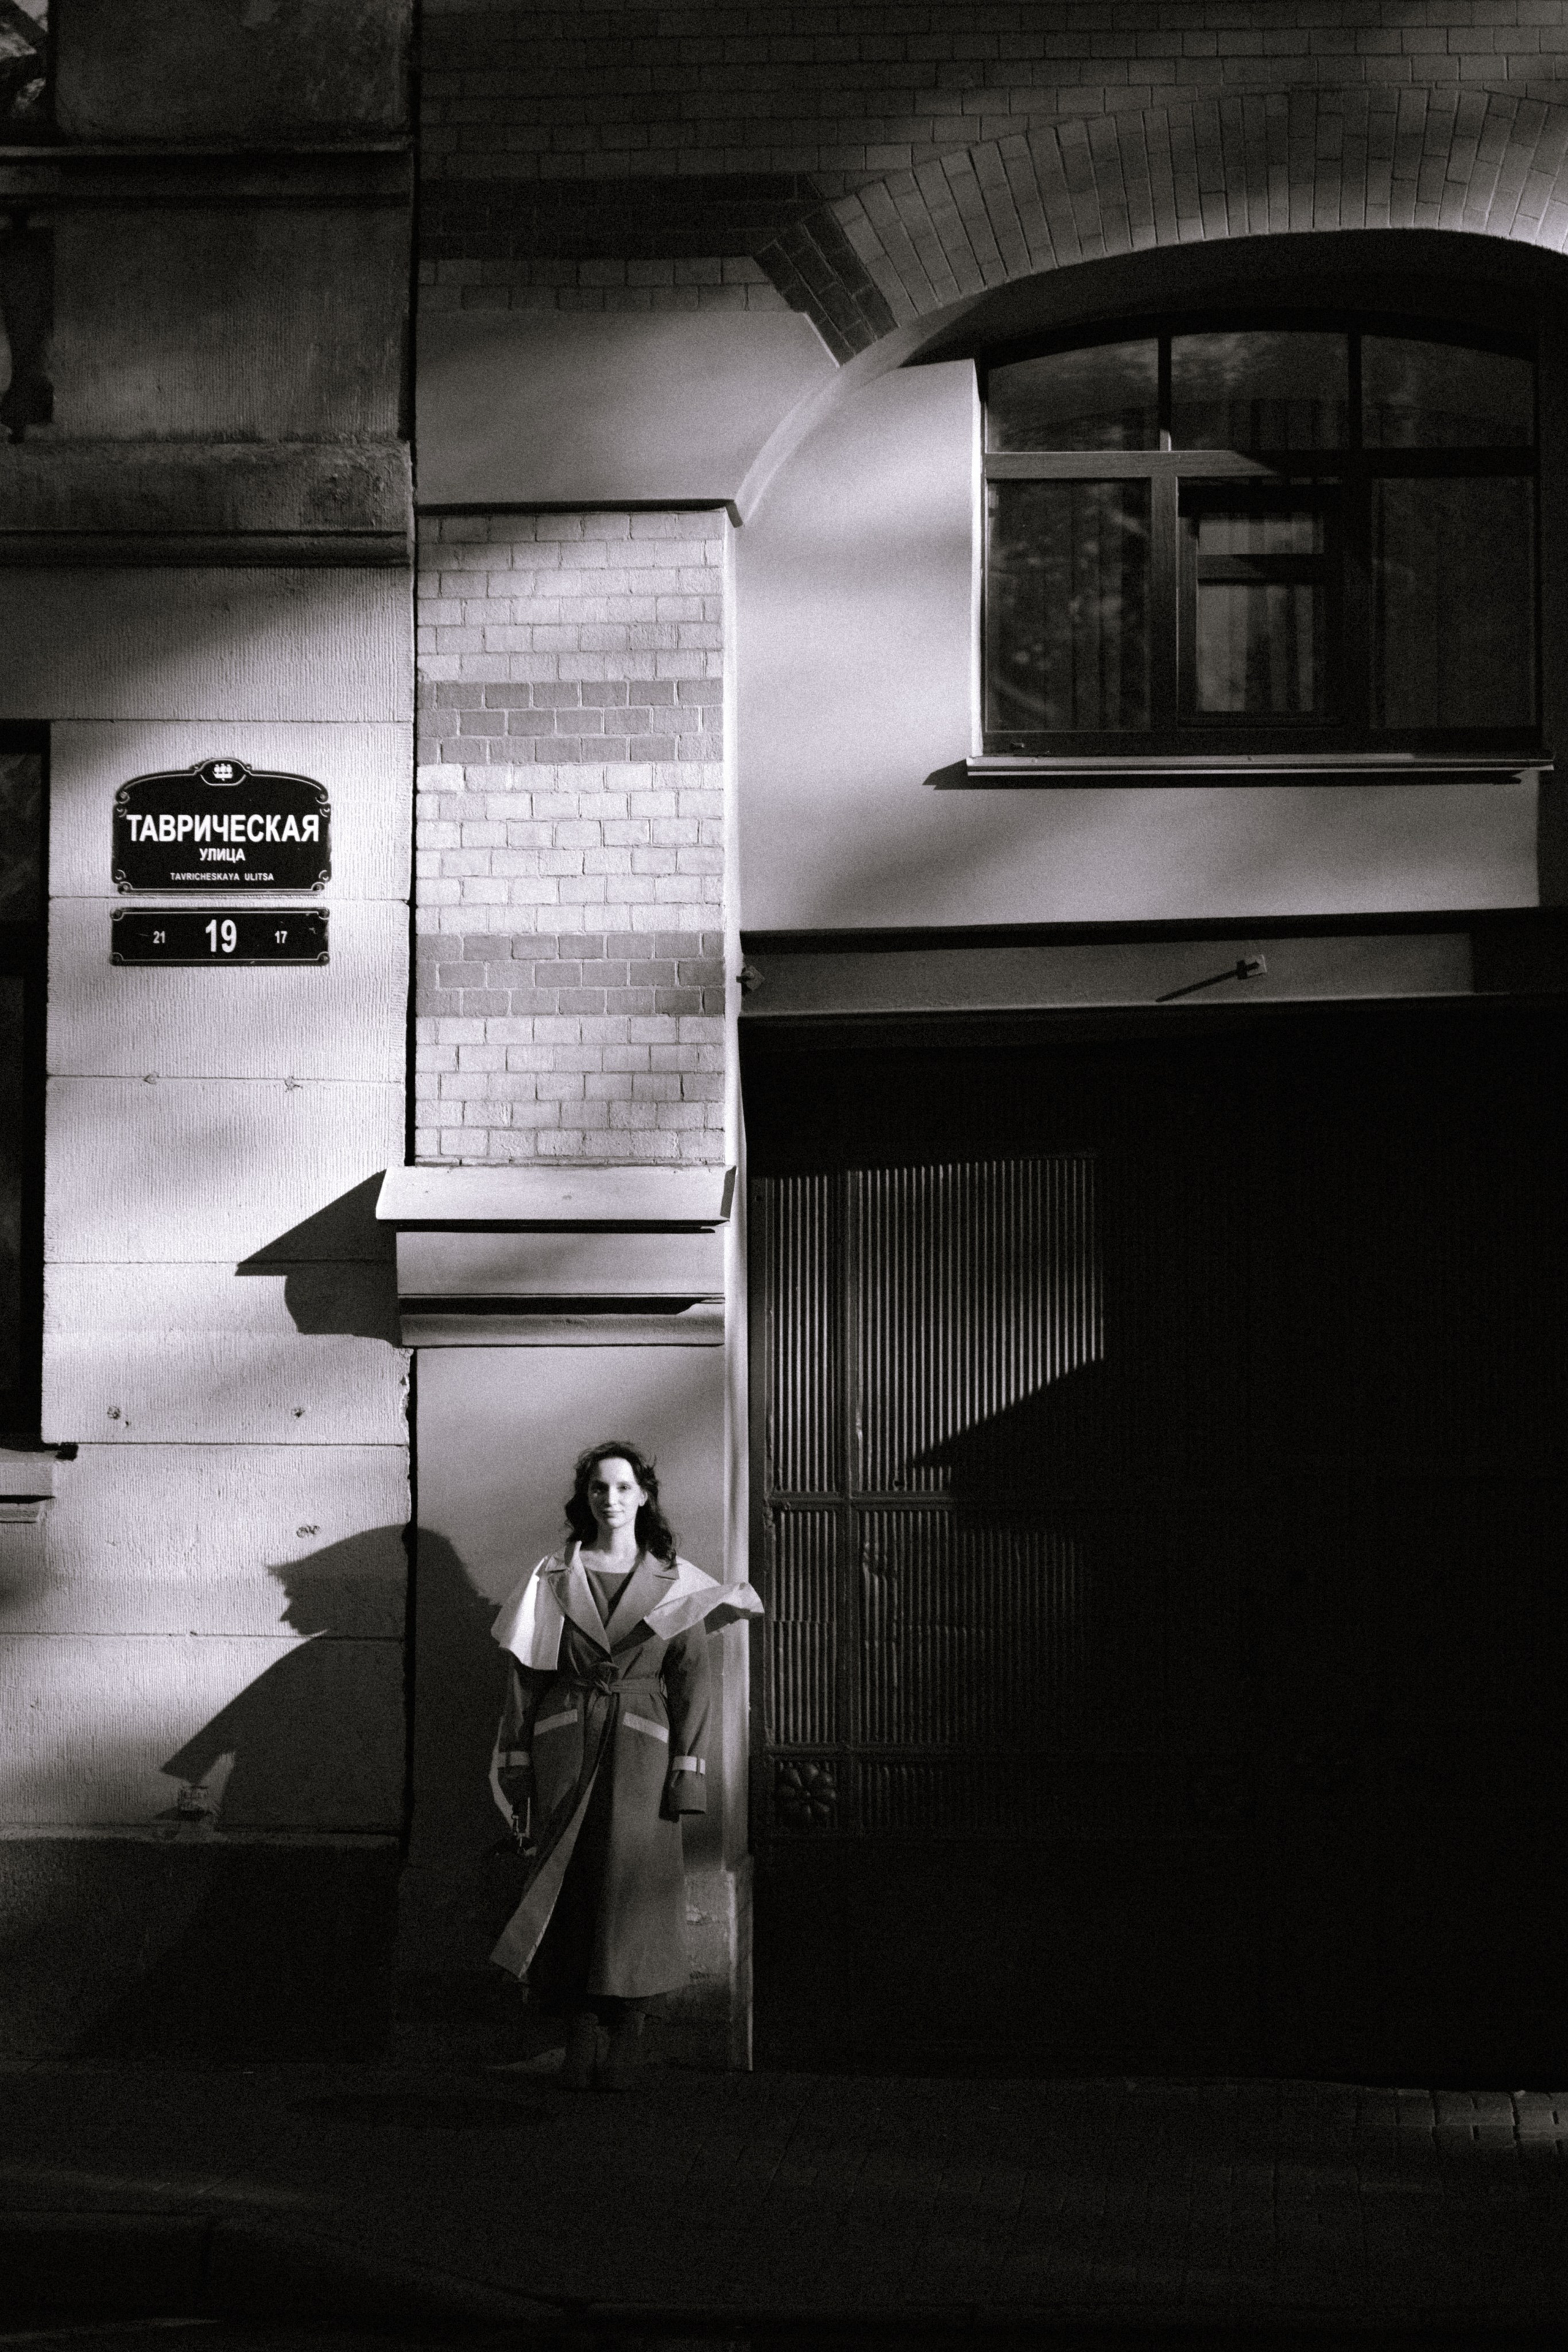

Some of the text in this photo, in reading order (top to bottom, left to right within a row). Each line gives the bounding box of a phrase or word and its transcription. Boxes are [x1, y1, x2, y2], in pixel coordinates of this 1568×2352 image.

[126, 815, 319, 842] ТАВРИЧЕСКАЯ
[199, 848, 246, 863] УЛИЦА
[153, 931, 165, 944] 21
[205, 919, 237, 952] 19
[275, 931, 288, 943] 17
